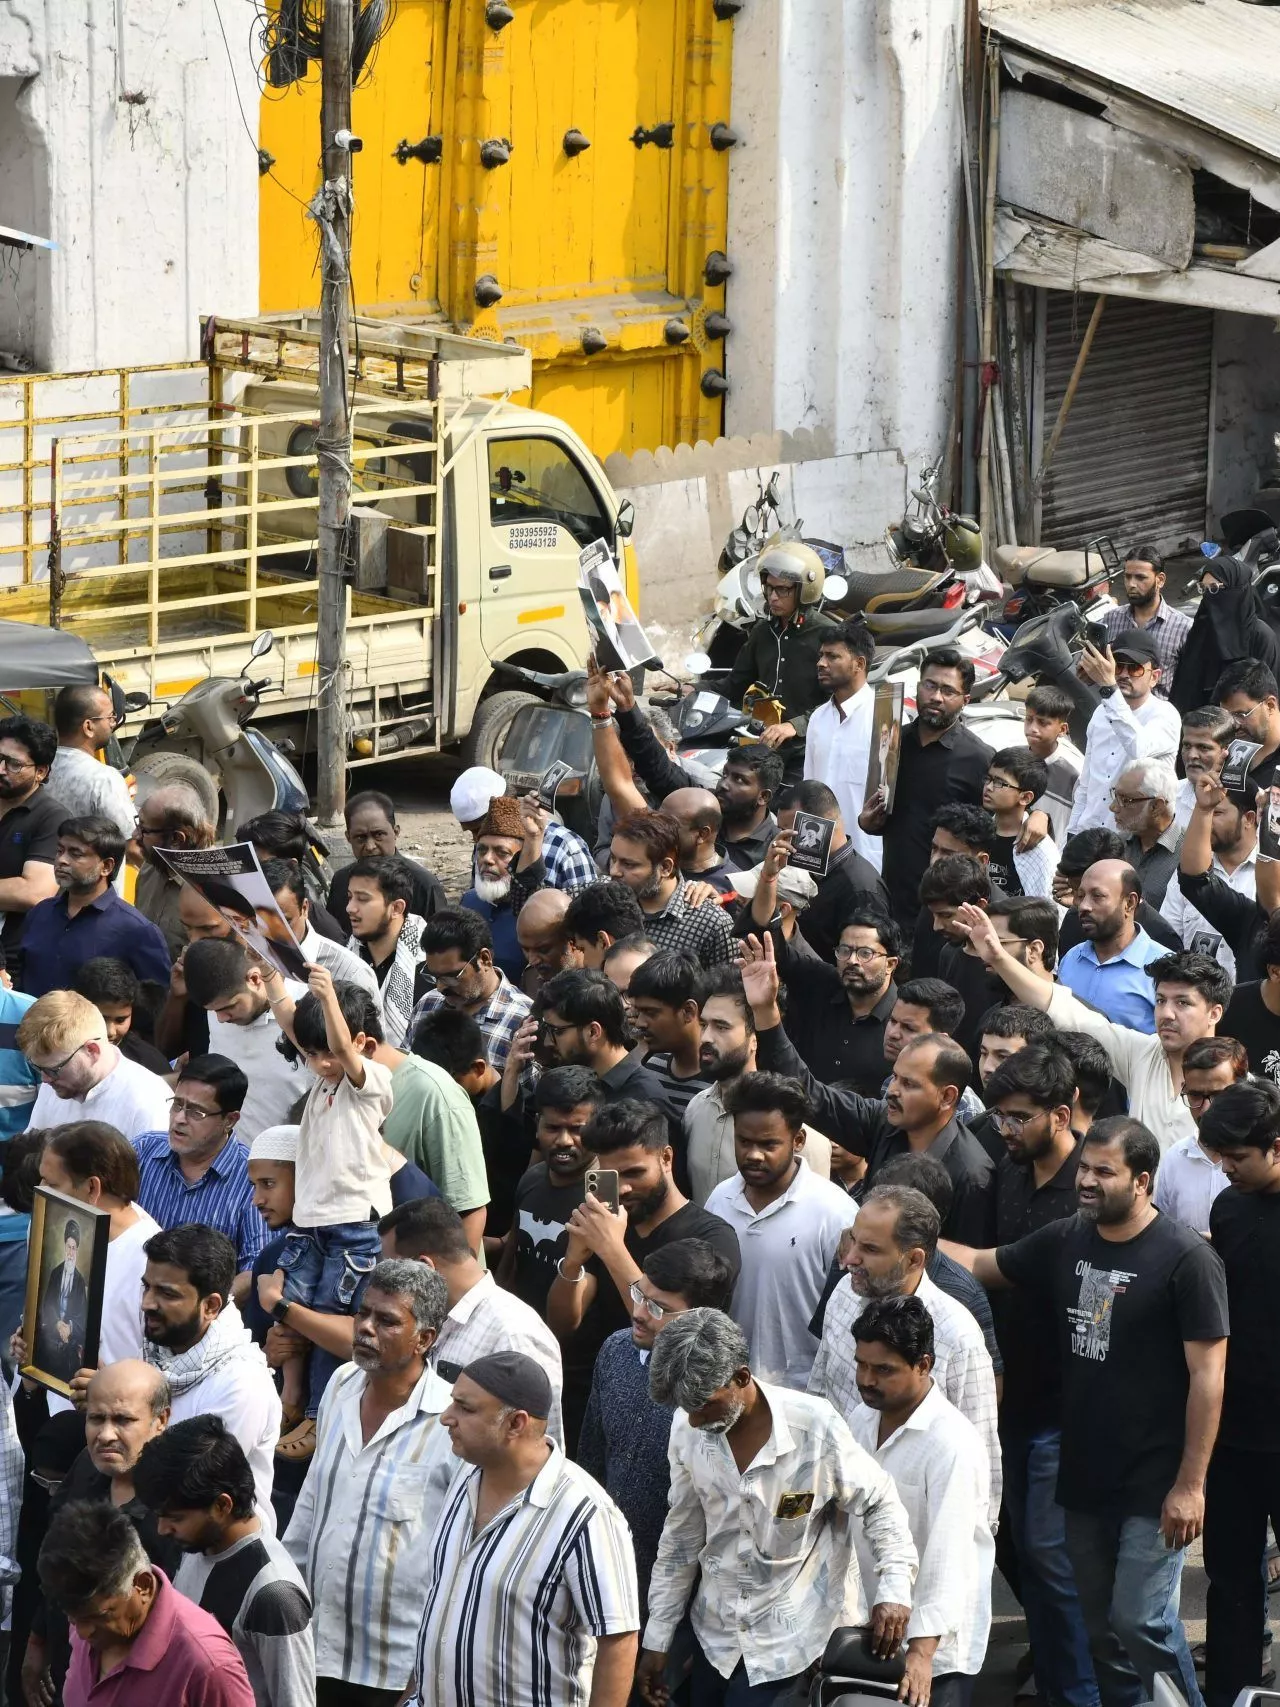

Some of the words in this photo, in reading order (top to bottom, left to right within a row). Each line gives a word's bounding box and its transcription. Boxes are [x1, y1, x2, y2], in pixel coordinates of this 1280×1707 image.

[509, 526, 557, 538] 9393955925
[509, 537, 557, 549] 6304943128
[1075, 1259, 1091, 1276] ON
[1071, 1332, 1106, 1362] DREAMS
